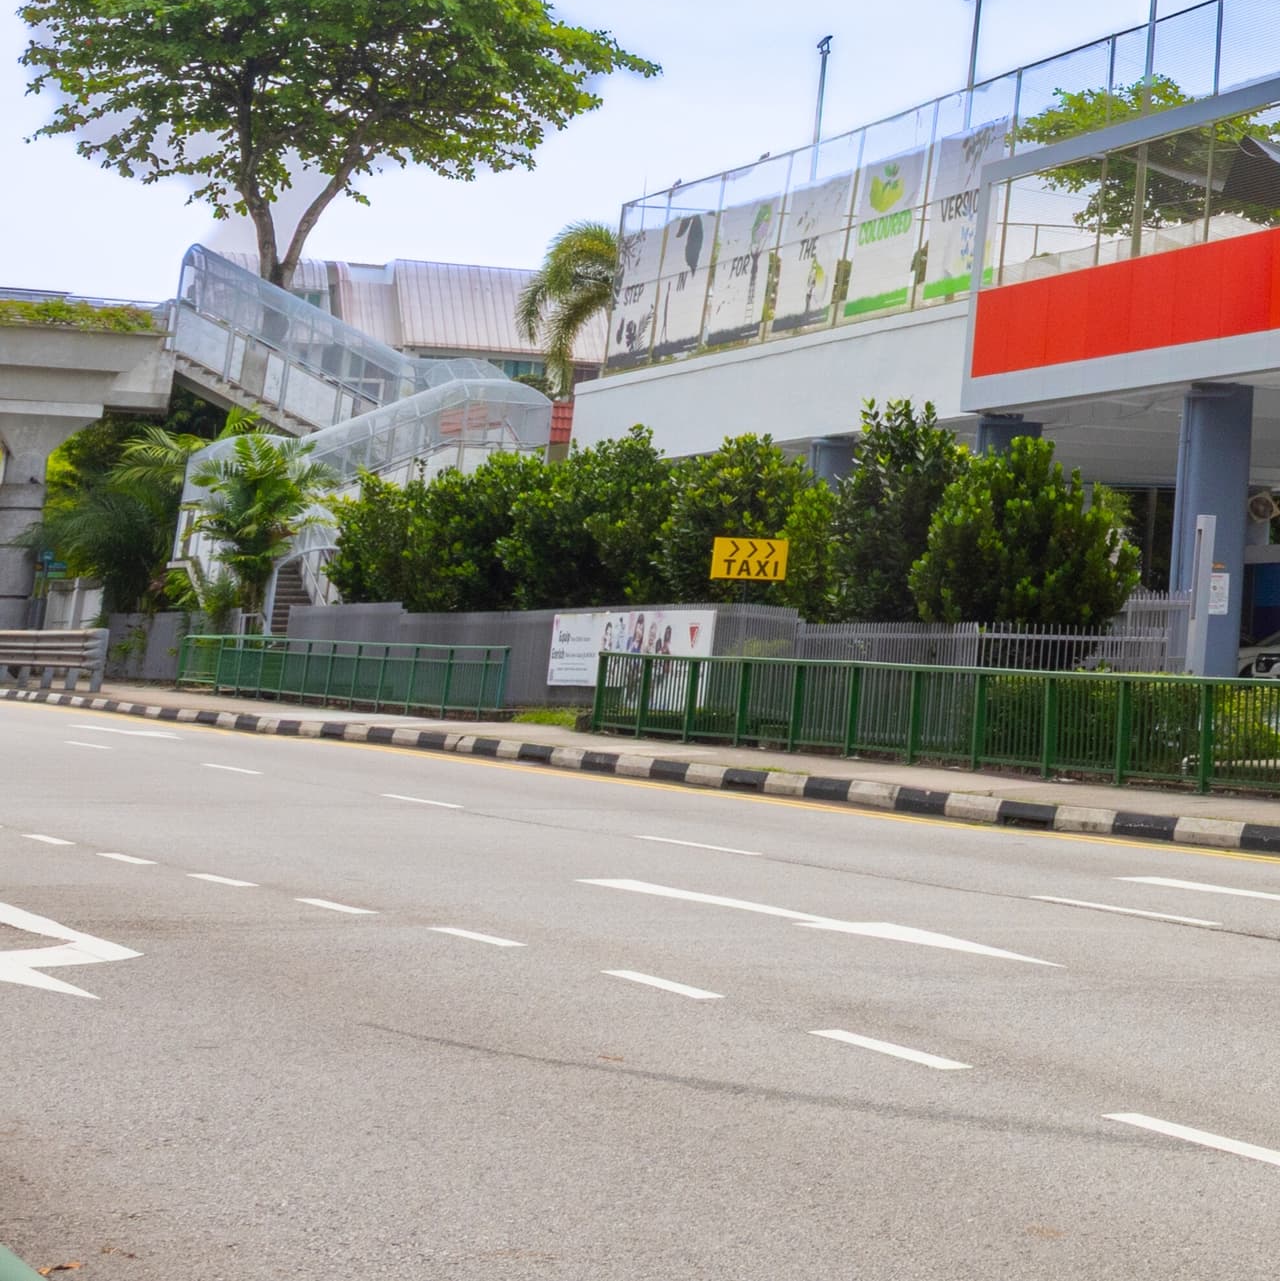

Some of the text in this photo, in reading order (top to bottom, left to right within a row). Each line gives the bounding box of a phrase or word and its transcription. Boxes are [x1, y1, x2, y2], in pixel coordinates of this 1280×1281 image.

[623, 283, 645, 306] STEP
[676, 270, 689, 292] IN
[729, 253, 750, 279] FOR
[799, 235, 819, 261] THE
[858, 208, 912, 247] COLOURED
[723, 558, 779, 577] TAXI
